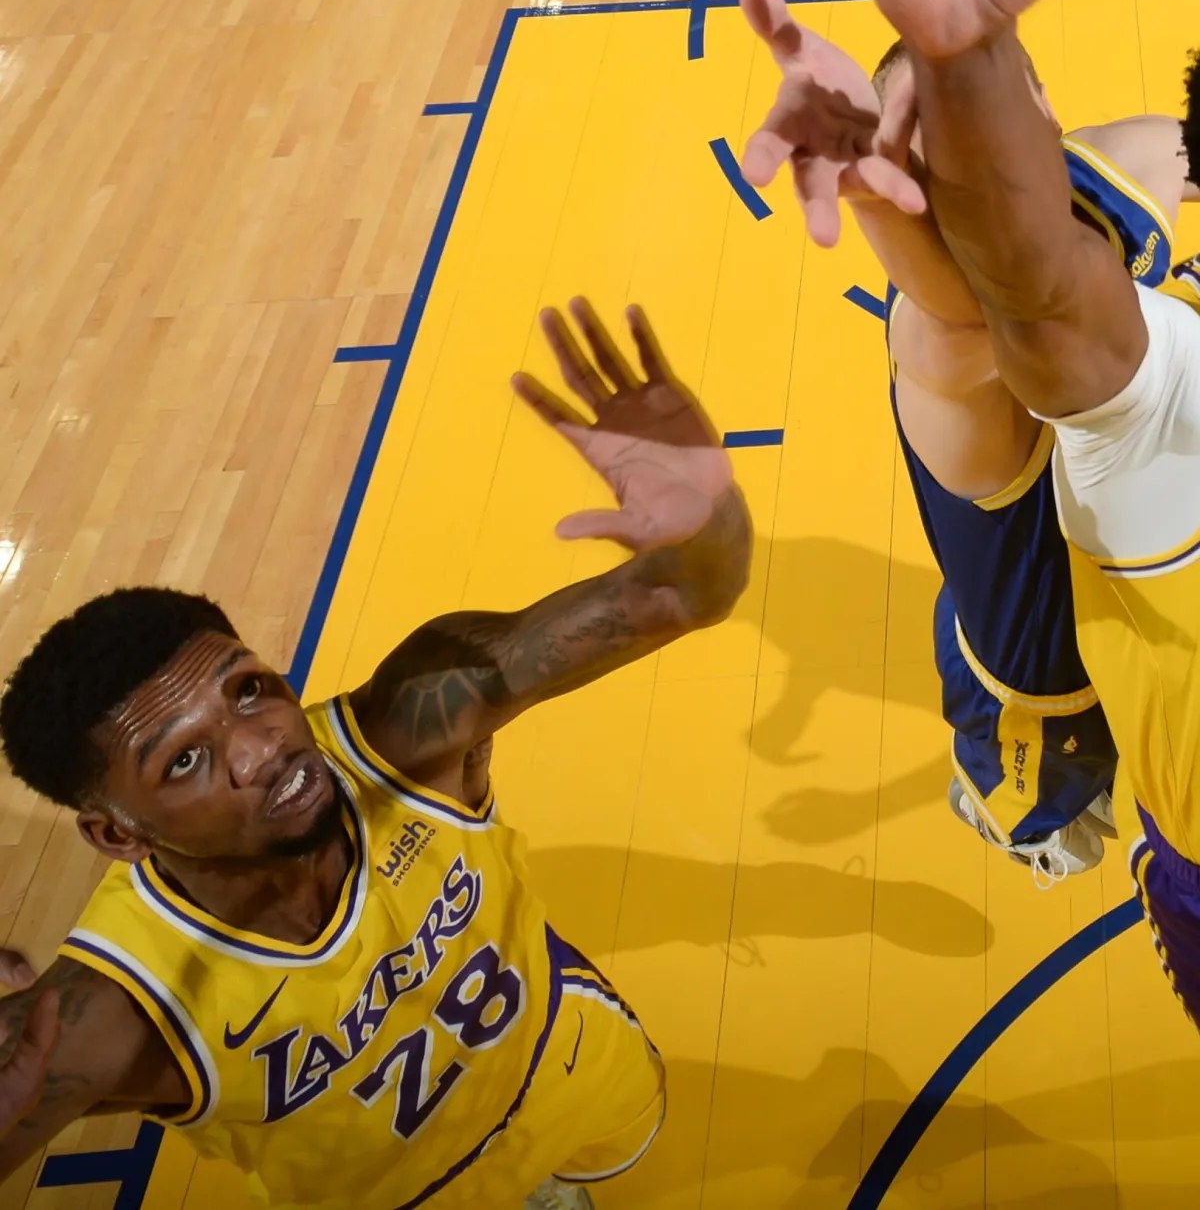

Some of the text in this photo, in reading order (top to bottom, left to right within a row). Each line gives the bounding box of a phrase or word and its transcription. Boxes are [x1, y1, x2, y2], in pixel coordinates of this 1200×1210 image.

[1131, 231, 1160, 278] akuten
[376, 820, 428, 878] wish
[392, 828, 437, 887] SHOPPING
[251, 853, 483, 1123] LAKERS
[350, 941, 527, 1141] 28
